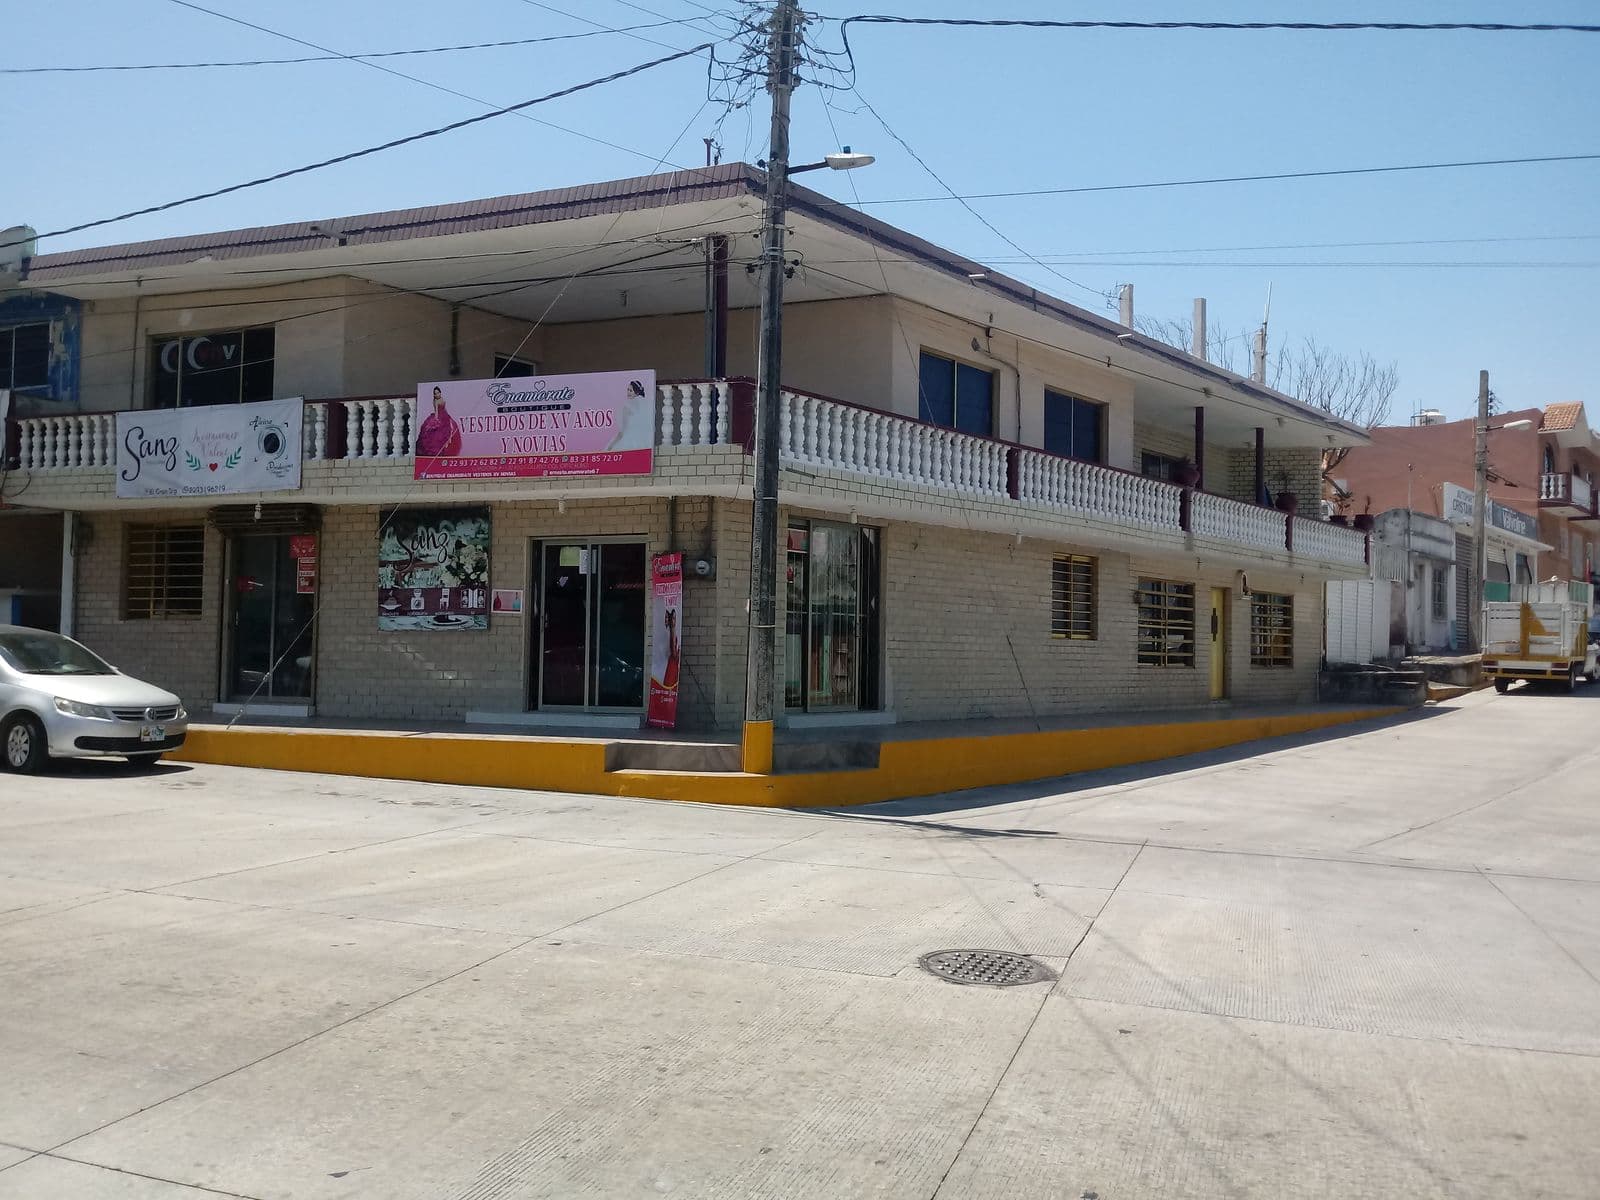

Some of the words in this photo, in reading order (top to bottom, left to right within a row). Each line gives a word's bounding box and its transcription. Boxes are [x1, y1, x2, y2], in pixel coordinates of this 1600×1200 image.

[486, 382, 575, 406] Enamorate
[460, 414, 525, 433] VESTIDOS
[529, 413, 546, 430] DE
[550, 411, 571, 429] XV
[122, 426, 179, 481] Sanz
[501, 437, 511, 453] Y
[512, 435, 566, 452] NOVIAS
